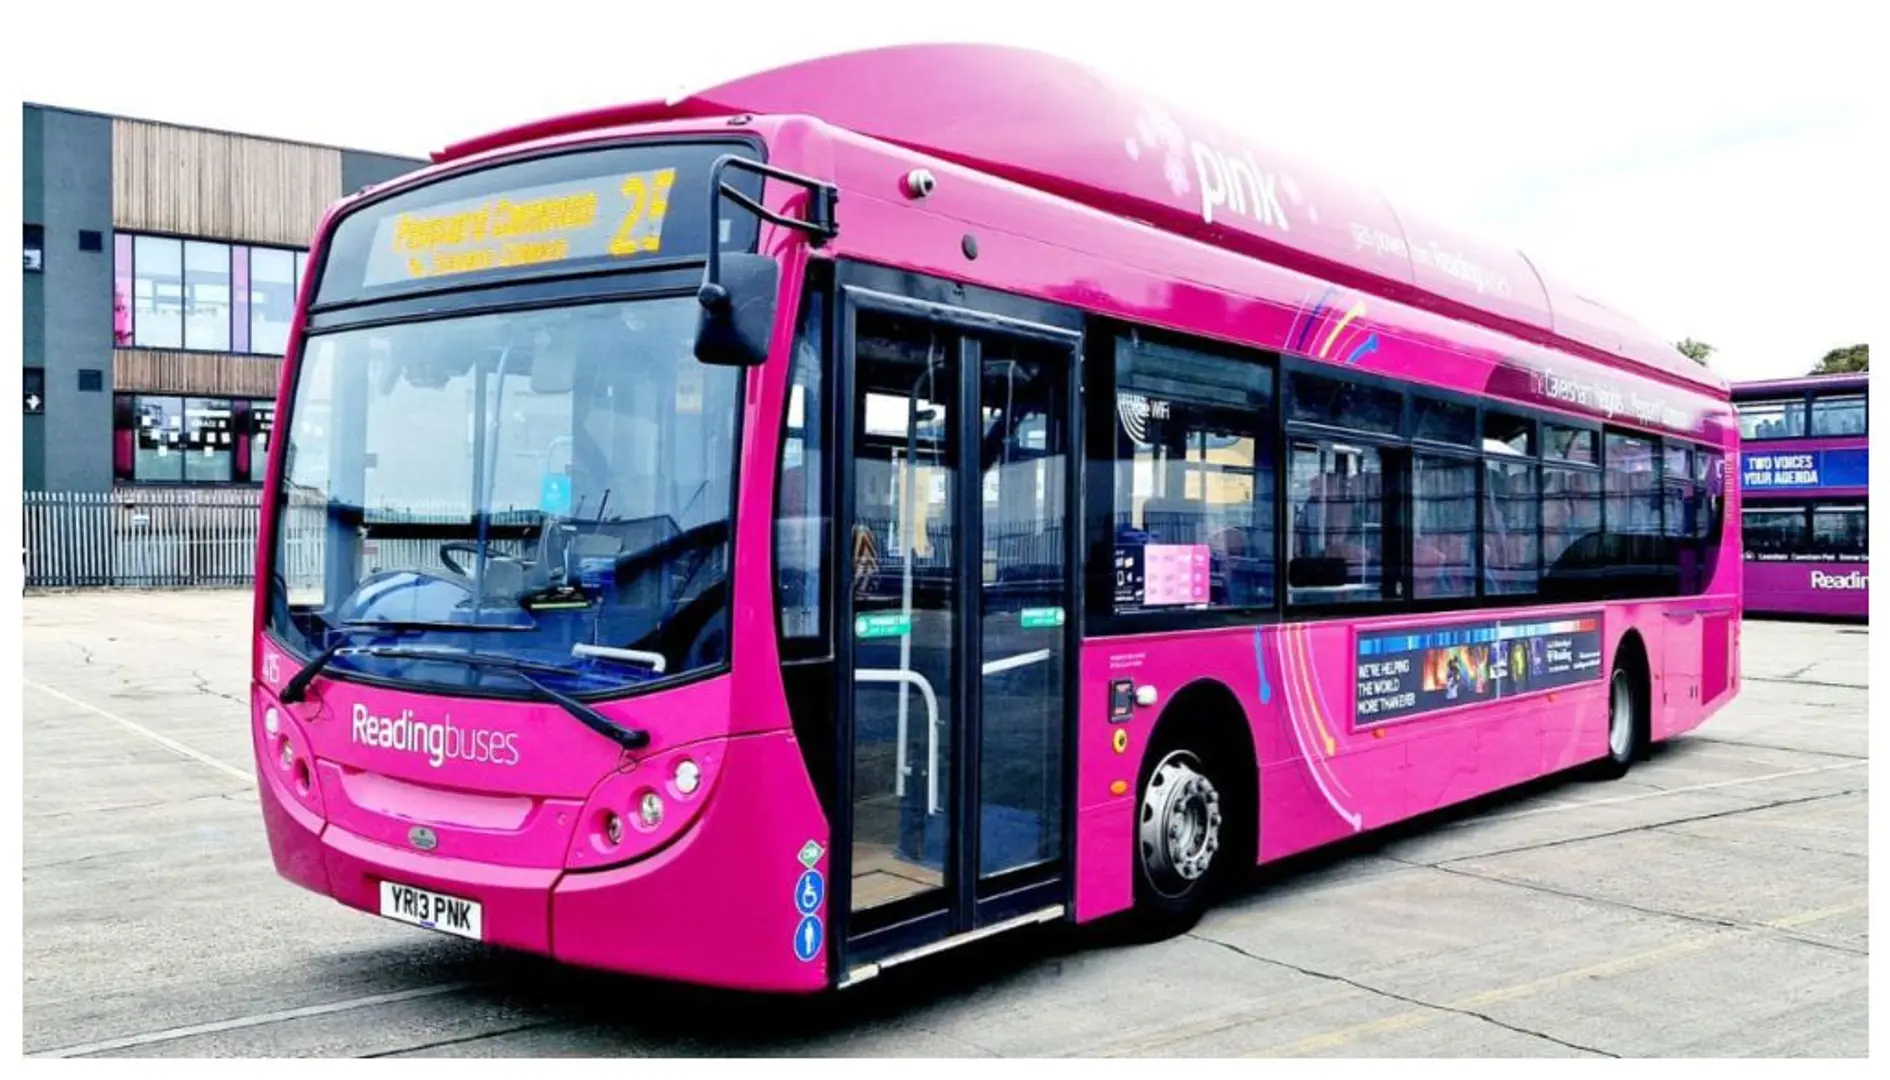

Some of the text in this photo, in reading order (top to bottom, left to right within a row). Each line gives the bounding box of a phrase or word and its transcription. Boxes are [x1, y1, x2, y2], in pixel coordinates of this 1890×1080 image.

[1191, 141, 1289, 230] pink
[1748, 455, 1813, 470] TWO VOICES
[1744, 470, 1818, 486] YOUR AGENDA
[1358, 681, 1373, 697] THE
[1358, 698, 1380, 714] MORE
[352, 703, 520, 768] Readingbuses
[391, 886, 472, 931] YR13 PNK
